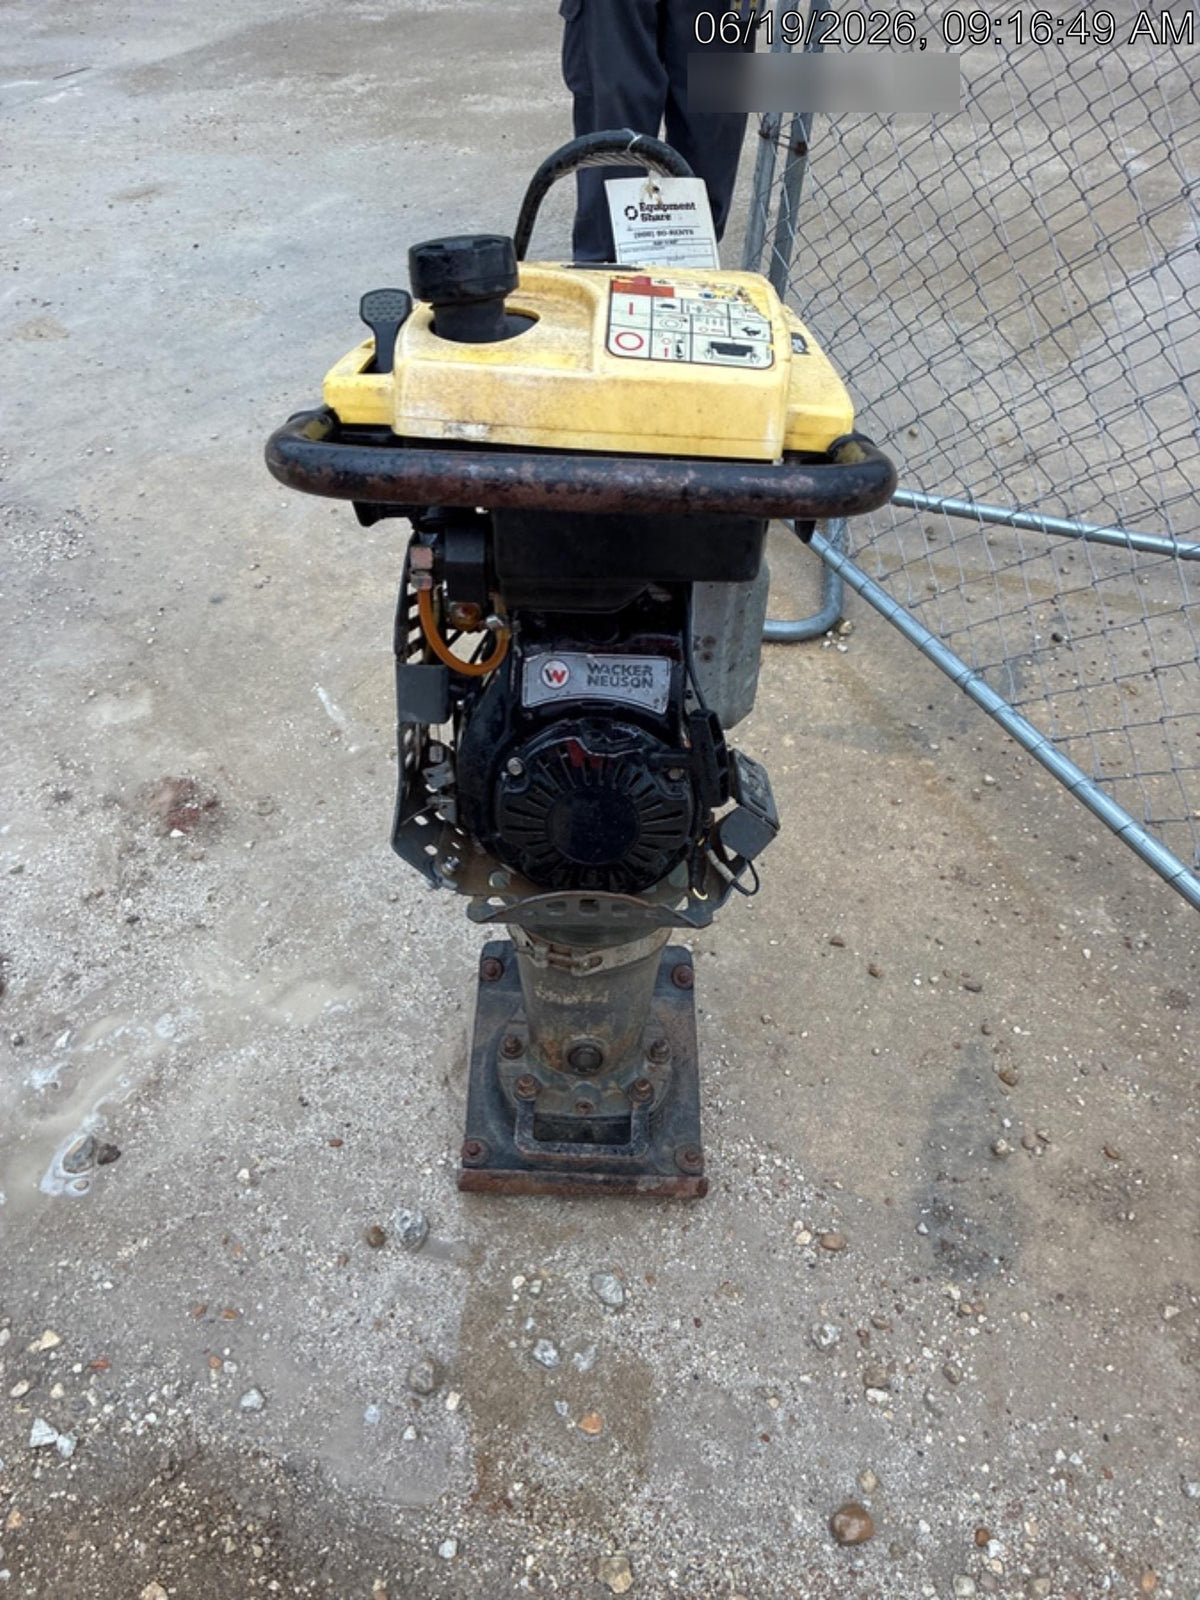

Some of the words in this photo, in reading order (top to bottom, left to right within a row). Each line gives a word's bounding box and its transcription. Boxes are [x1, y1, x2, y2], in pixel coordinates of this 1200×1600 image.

[639, 202, 696, 212] Equipment
[640, 213, 671, 222] Share
[586, 662, 653, 676] WACKER
[586, 675, 654, 688] NEUSON
